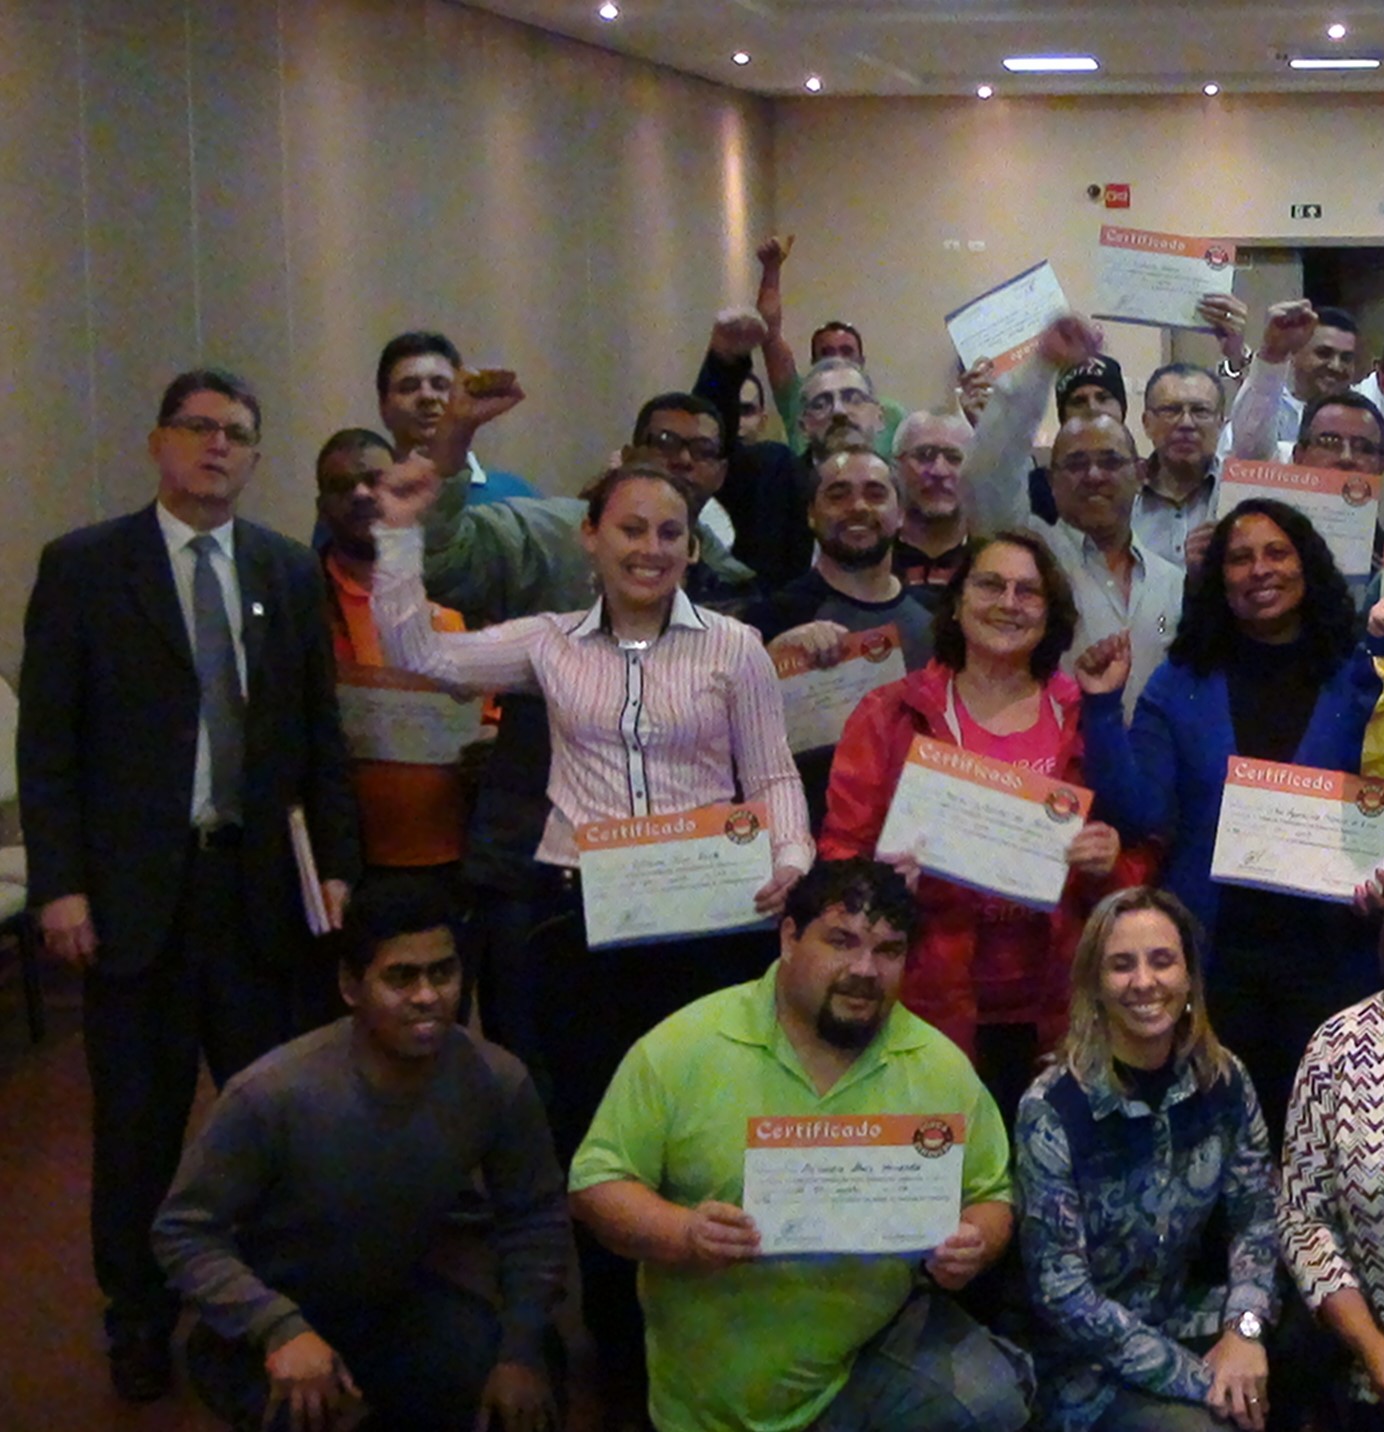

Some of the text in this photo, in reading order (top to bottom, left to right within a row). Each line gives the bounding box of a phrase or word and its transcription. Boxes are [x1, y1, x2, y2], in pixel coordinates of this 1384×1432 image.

[1106, 229, 1187, 251] Certificado
[1227, 460, 1320, 486] Certificado
[918, 743, 1024, 789] Certificado
[1234, 762, 1334, 792] Certificado
[585, 817, 697, 843] Certificado
[755, 1120, 882, 1140] Certificado
